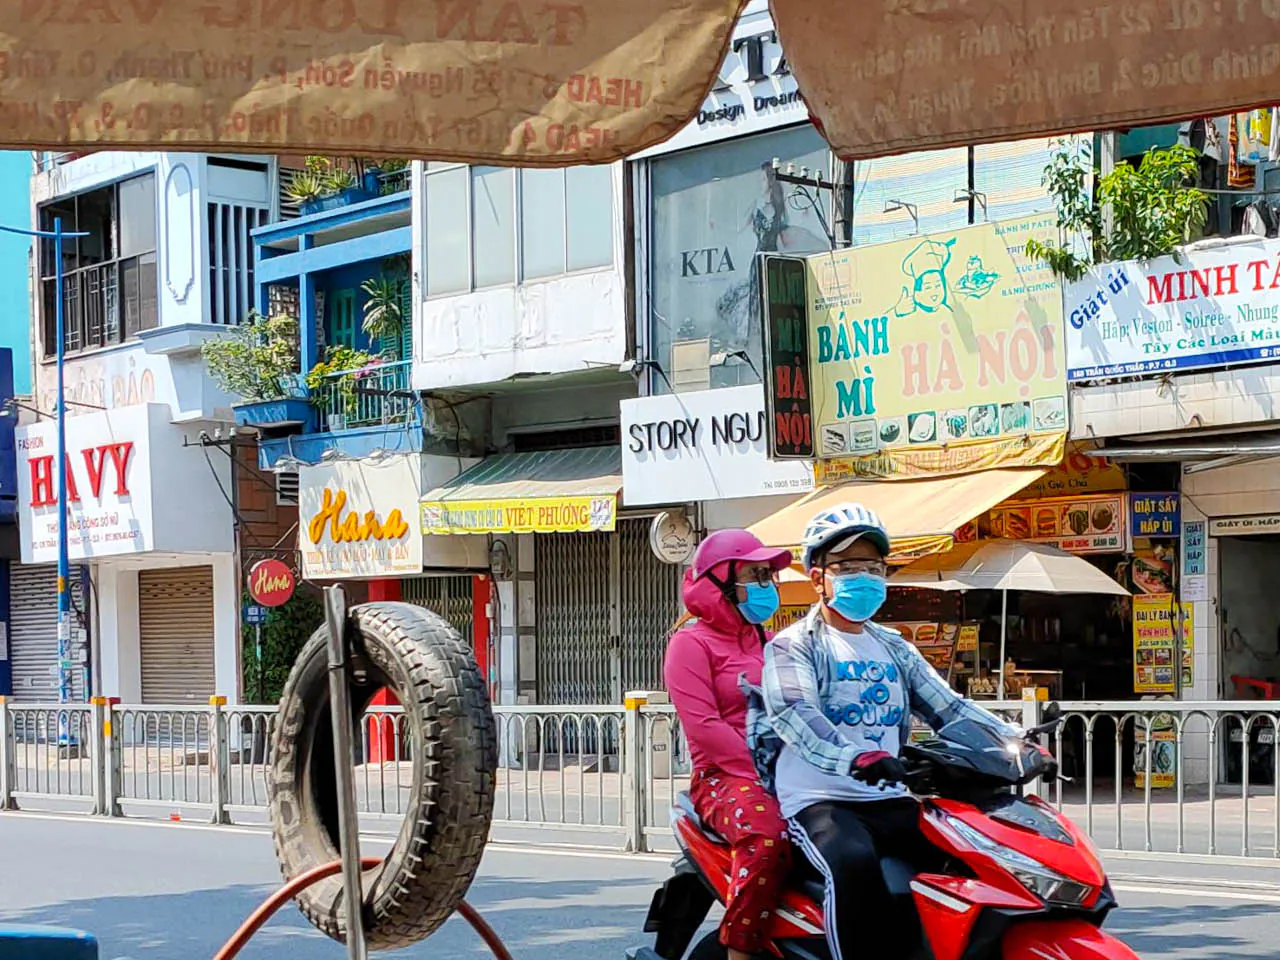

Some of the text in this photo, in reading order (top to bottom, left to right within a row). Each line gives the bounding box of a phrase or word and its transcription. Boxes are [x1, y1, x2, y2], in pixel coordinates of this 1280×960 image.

[696, 103, 745, 125] Design
[681, 246, 735, 278] KTA
[1147, 264, 1239, 305] MINH
[1132, 315, 1173, 338] Veston
[1237, 303, 1278, 326] Nhung
[816, 309, 1059, 398] BÁNH HÀ NỘI
[1177, 333, 1205, 350] Các
[1211, 331, 1246, 348] Loại
[835, 365, 876, 418] MÌ
[628, 417, 700, 453] STORY
[775, 402, 811, 454] NỘI
[308, 487, 409, 545] Hana
[538, 503, 589, 526] PHƯƠNG
[254, 567, 291, 596] Hana
